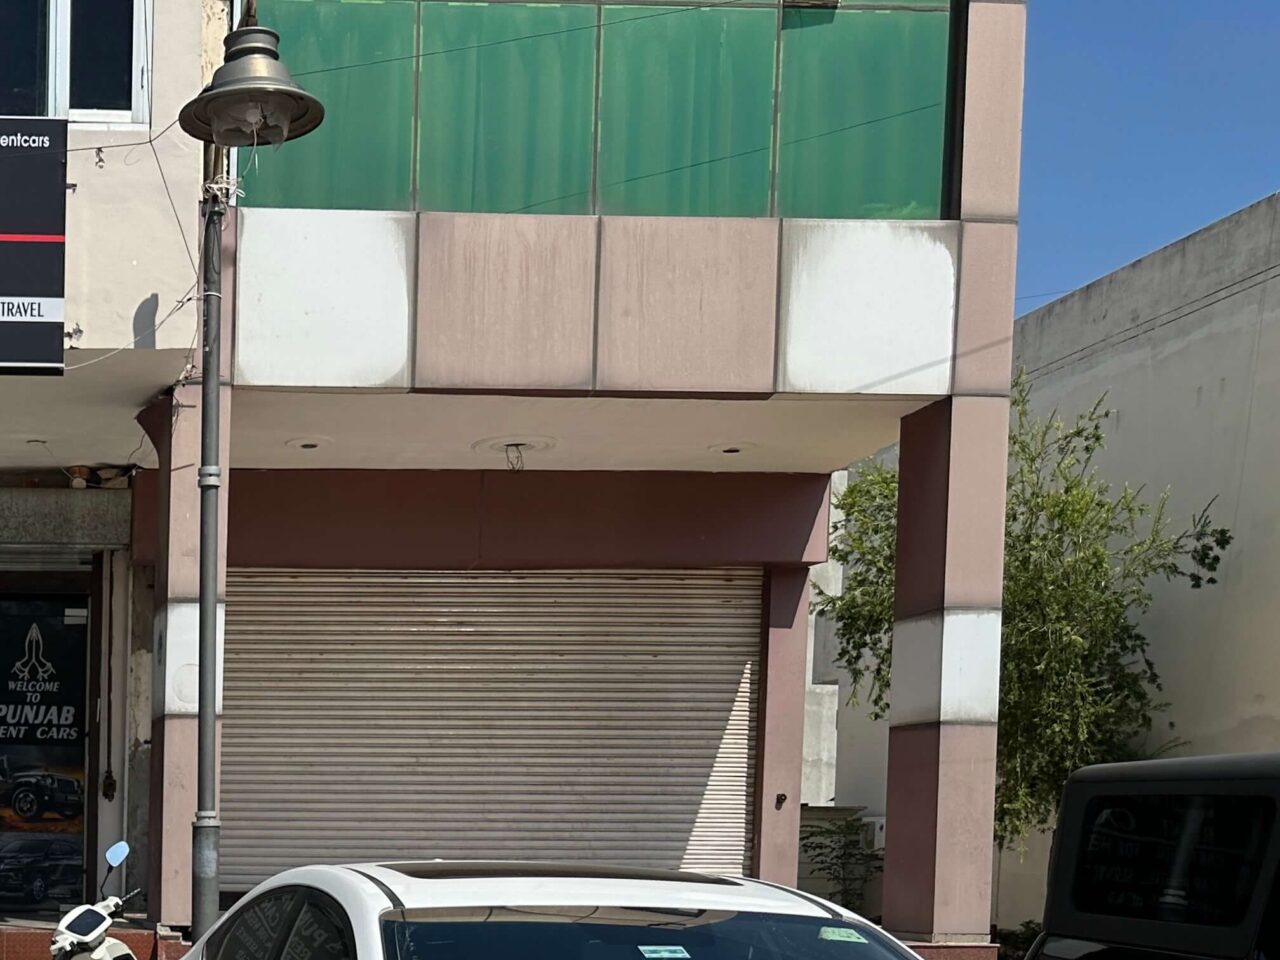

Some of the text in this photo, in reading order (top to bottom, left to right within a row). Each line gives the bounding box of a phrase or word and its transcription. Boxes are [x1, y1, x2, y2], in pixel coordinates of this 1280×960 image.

[0, 301, 44, 318] TRAVEL
[8, 680, 61, 692] WELCOME
[26, 692, 40, 703] TO
[36, 726, 79, 740] CARS
